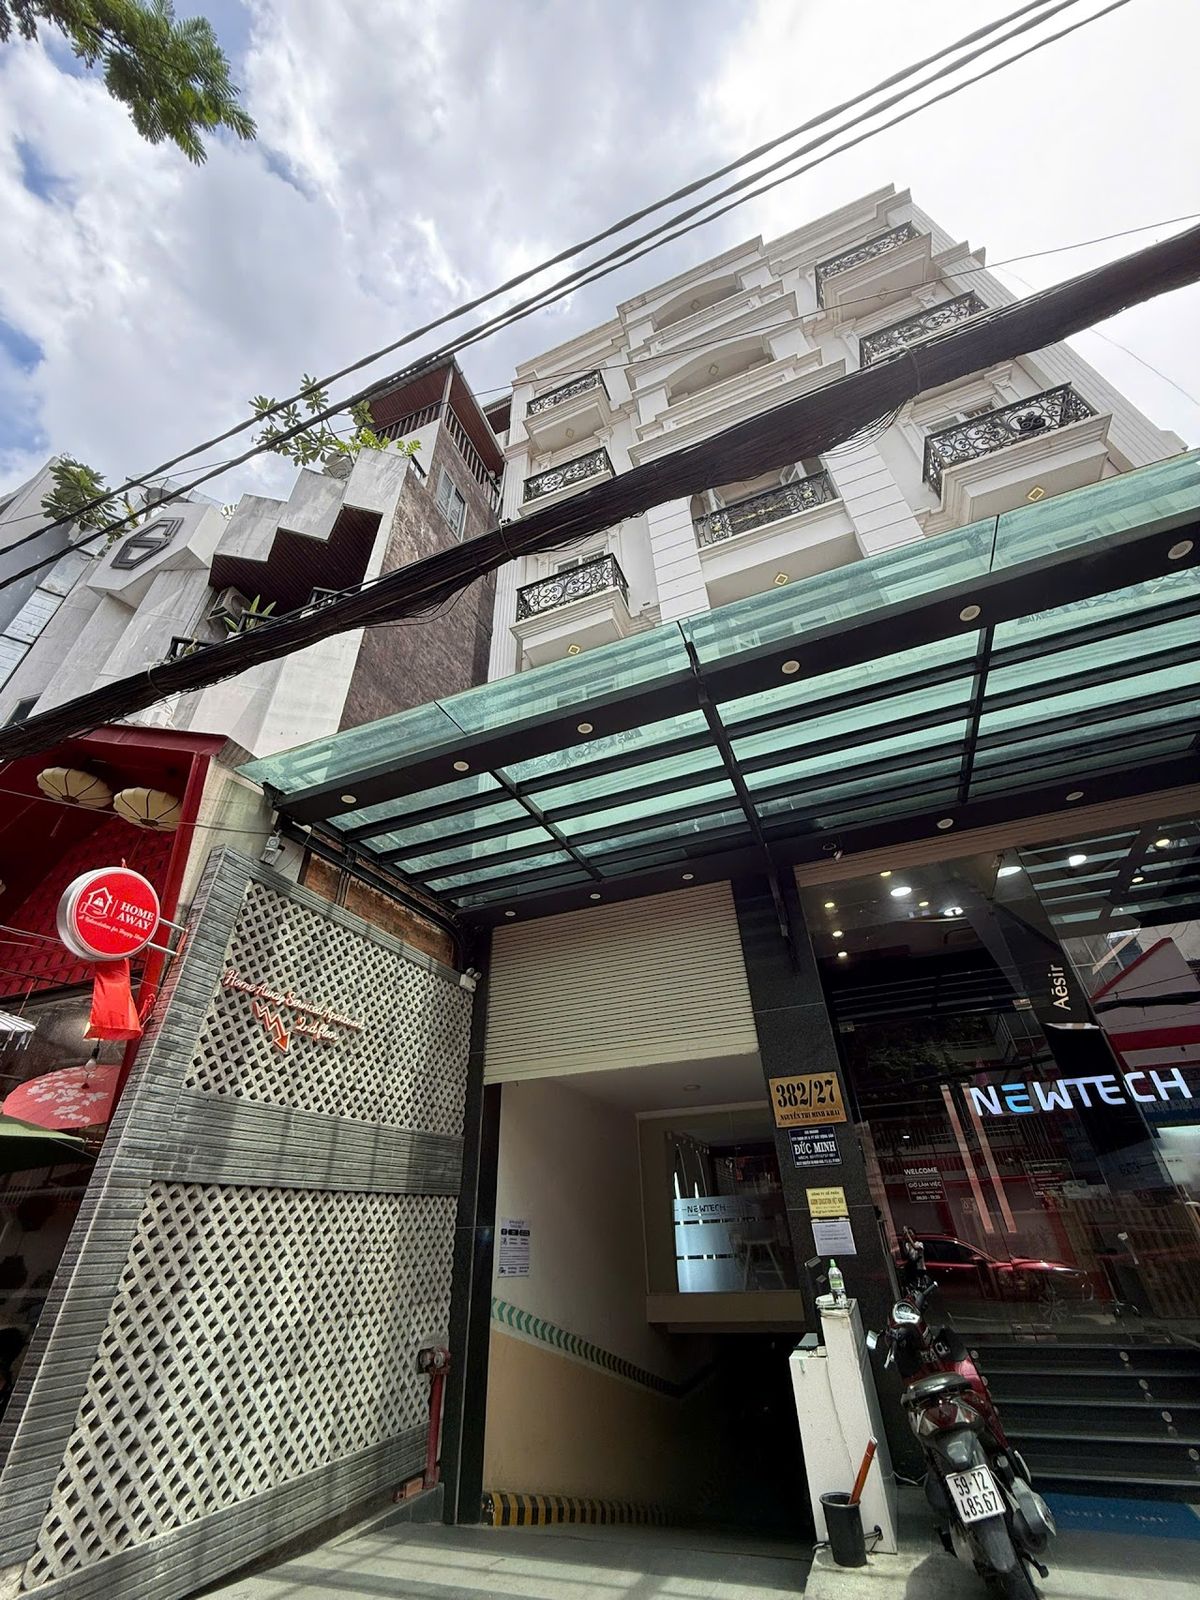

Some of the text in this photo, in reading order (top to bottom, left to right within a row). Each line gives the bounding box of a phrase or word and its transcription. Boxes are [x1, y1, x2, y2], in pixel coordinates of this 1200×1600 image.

[117, 912, 152, 930] AWAY
[120, 901, 155, 921] HOME
[1048, 965, 1071, 1011] Aēsir
[222, 969, 365, 1030] Home Away Serviced Apartment
[295, 1016, 318, 1035] 2nd
[776, 1079, 835, 1107] 382/27
[969, 1067, 1193, 1117] NEWTECH
[793, 1141, 836, 1154] ĐỨC MINH
[903, 1166, 938, 1175] WELCOME
[687, 1203, 727, 1213] NEWTECH
[953, 1471, 989, 1496] 59-T2
[960, 1491, 998, 1518] 485.67
